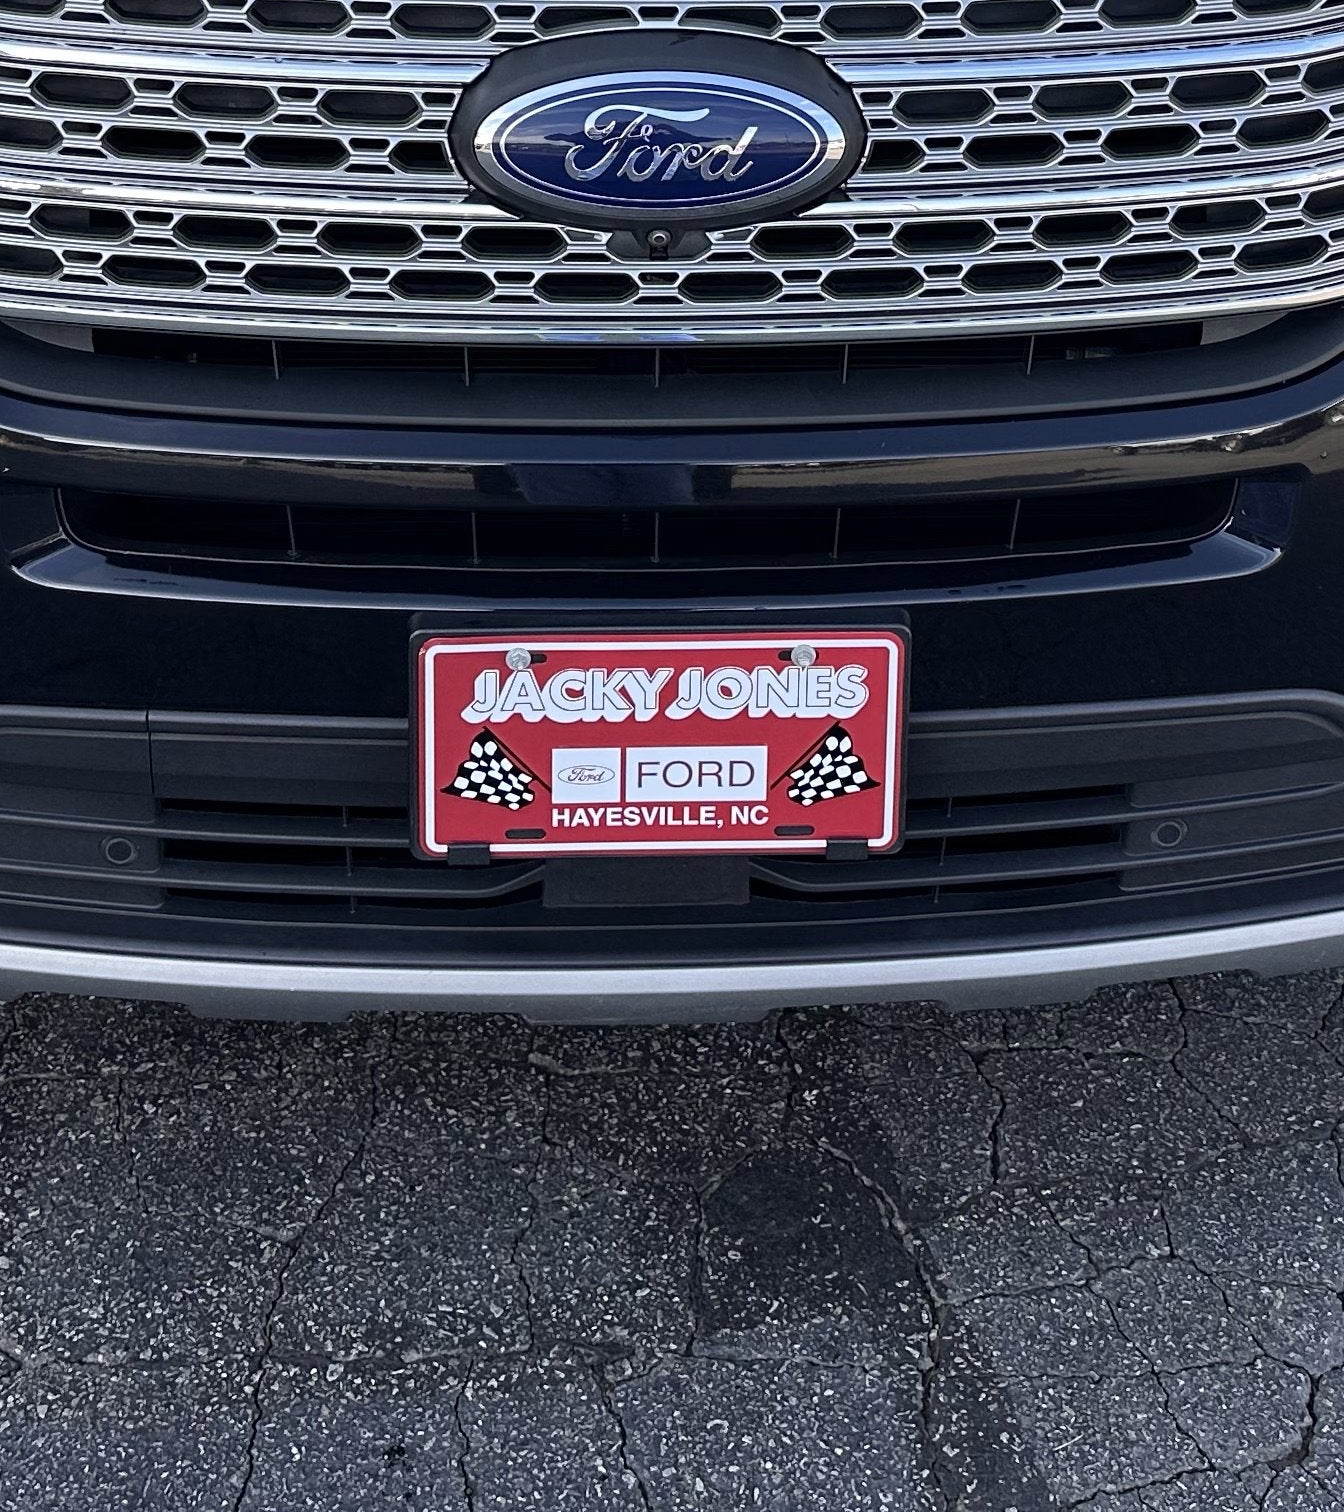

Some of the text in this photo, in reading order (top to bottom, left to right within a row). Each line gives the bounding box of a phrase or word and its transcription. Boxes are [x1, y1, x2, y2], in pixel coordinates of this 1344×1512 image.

[564, 104, 759, 183] Ford
[461, 664, 870, 723] JACKY JONES
[567, 760, 756, 789] Ford FORD
[551, 805, 770, 829] HAYESVILLE, NC
